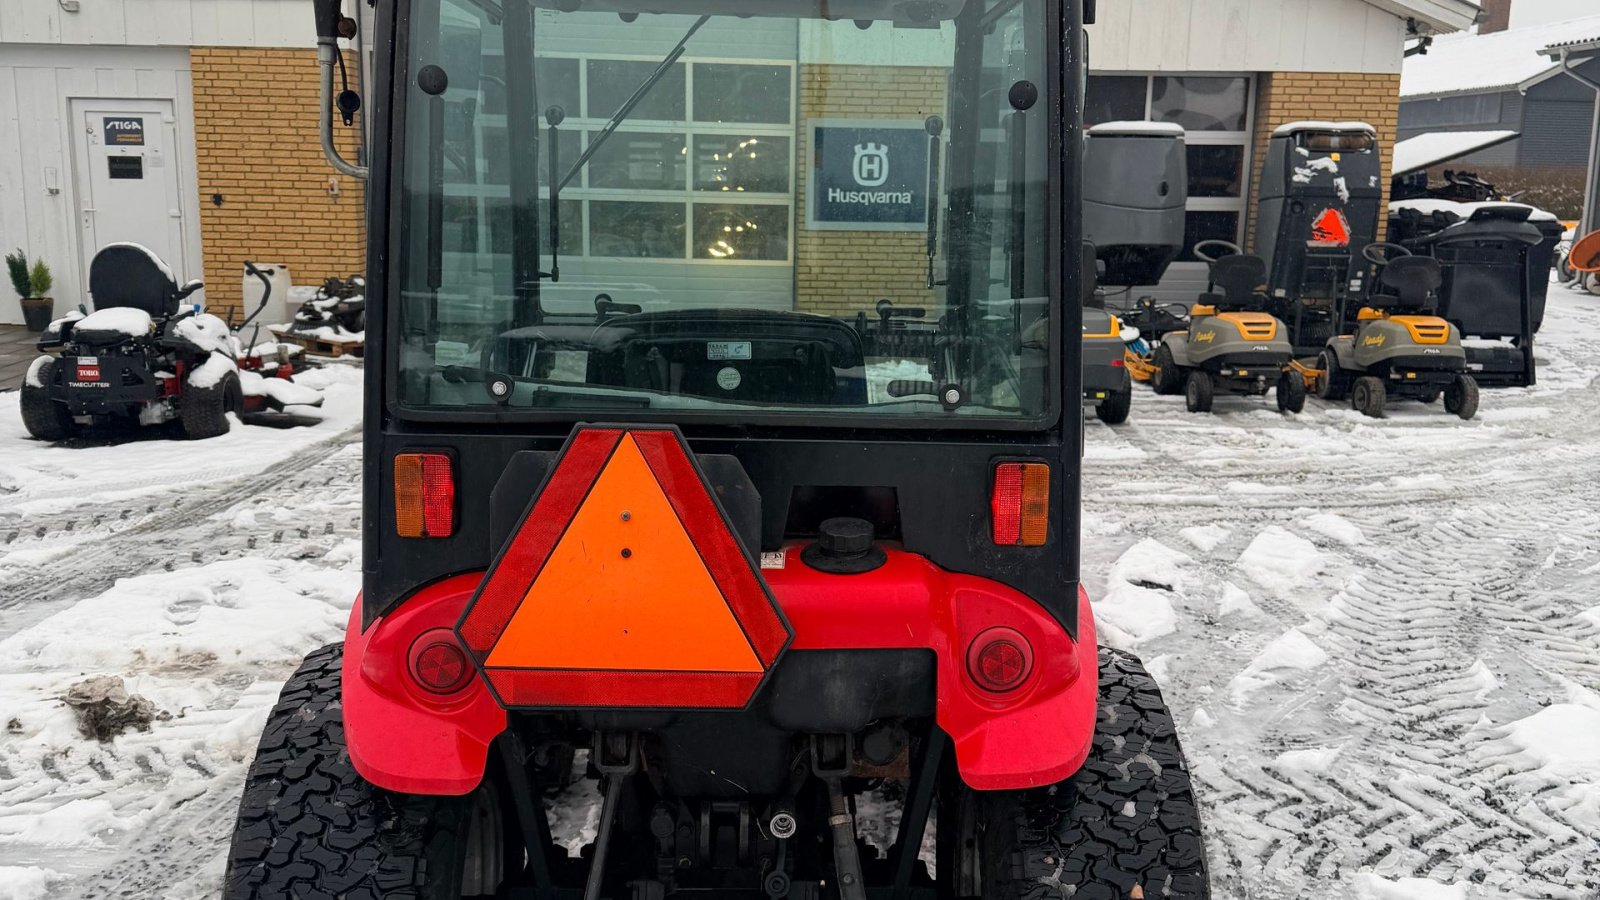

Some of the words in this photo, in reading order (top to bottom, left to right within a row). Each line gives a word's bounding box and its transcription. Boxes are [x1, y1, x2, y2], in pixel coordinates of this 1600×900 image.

[105, 121, 142, 130] STIGA
[828, 187, 912, 206] Husqvarna
[1362, 333, 1386, 347] Ready
